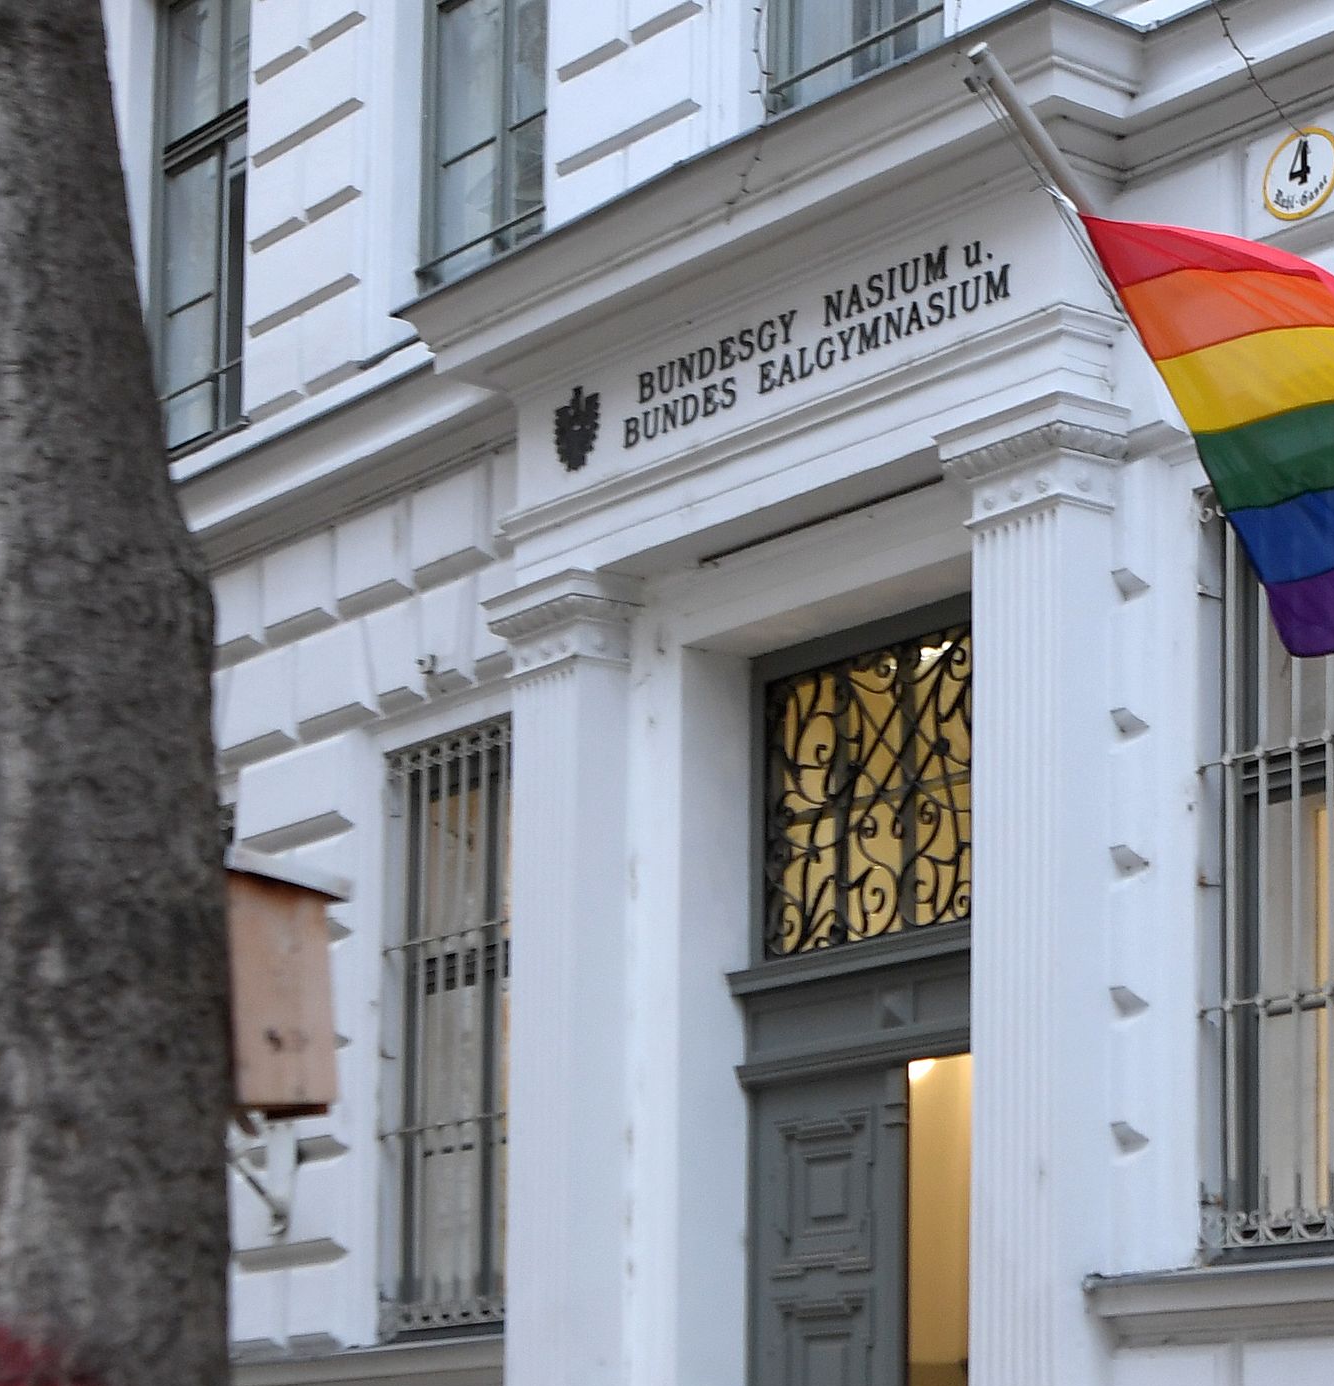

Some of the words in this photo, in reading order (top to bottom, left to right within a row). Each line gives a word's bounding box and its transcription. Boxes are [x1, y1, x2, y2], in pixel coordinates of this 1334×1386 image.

[1288, 138, 1311, 186] 4
[622, 376, 738, 450] BUNDES
[757, 264, 1012, 396] EALGYMNASIUM
[636, 309, 799, 405] BUNDESGY
[823, 244, 950, 329] NASIUM
[963, 239, 994, 266] u.
